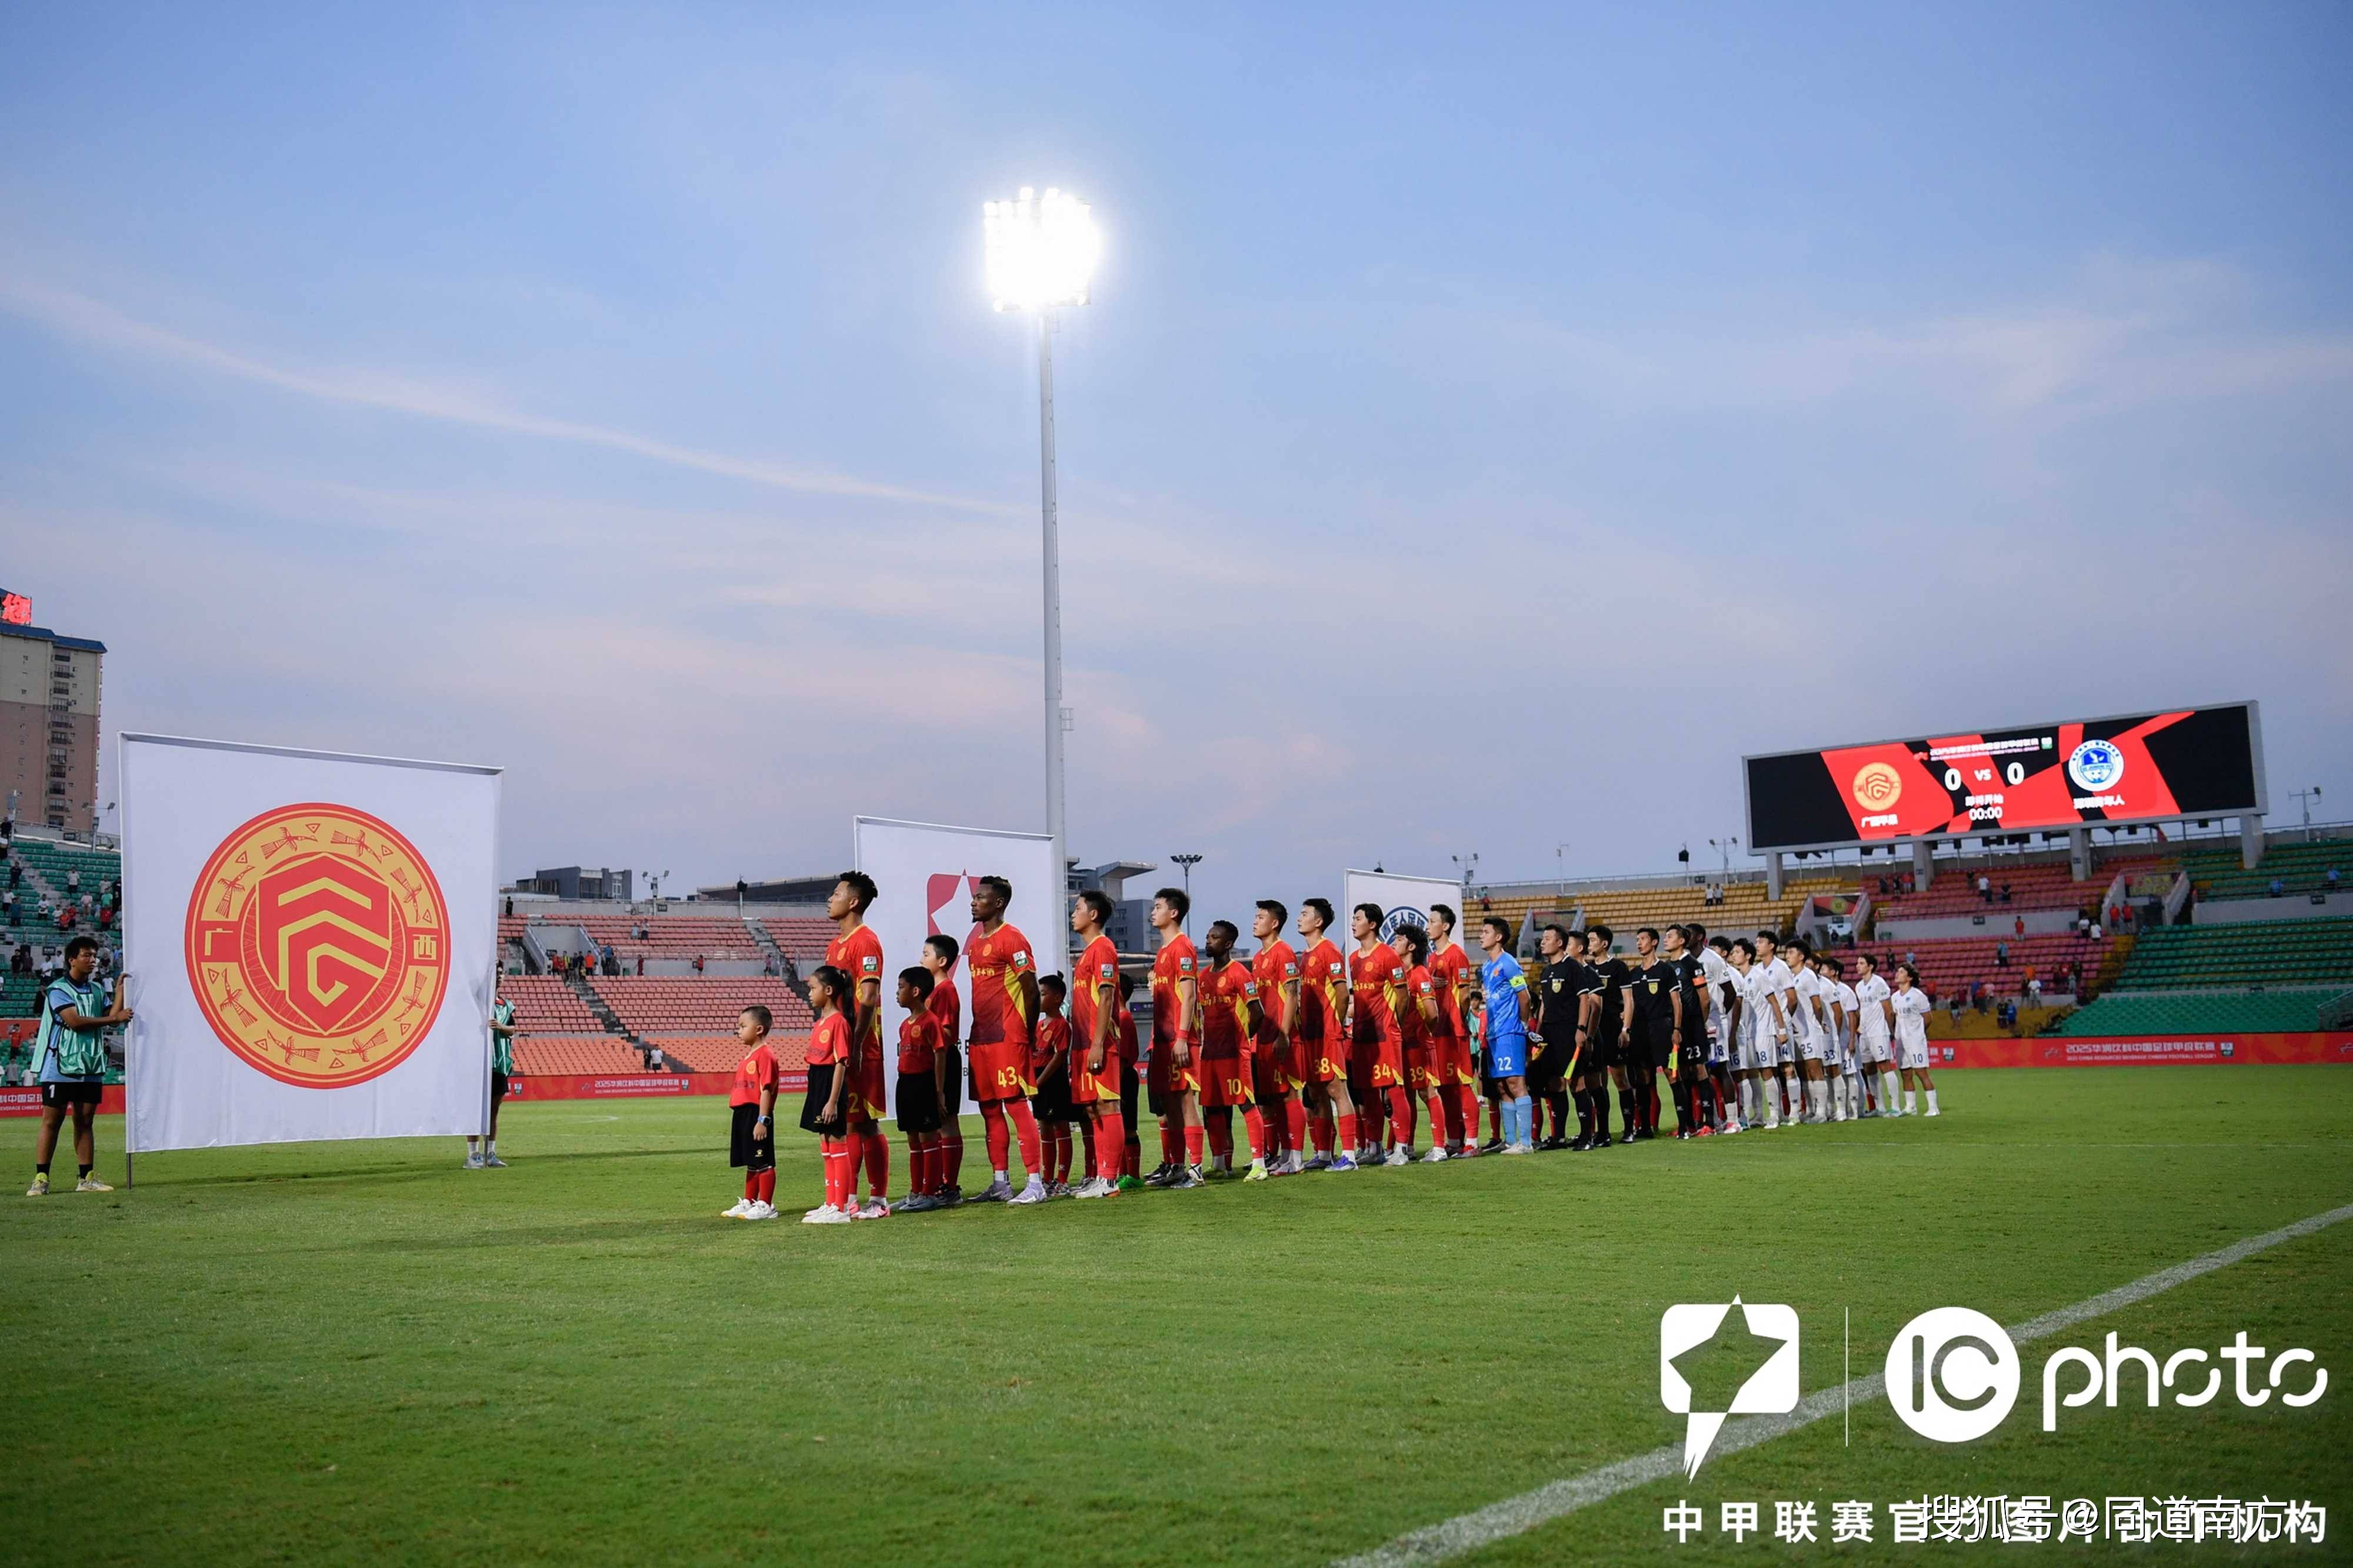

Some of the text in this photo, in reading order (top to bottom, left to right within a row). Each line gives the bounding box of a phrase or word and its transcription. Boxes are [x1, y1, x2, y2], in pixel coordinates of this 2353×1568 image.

[1945, 762, 2024, 791] 0 VS 0
[1969, 806, 2003, 820] 00:00
[1686, 1045, 1701, 1059] 23
[1777, 1046, 1789, 1057] 14
[1801, 1043, 1812, 1055] 25
[1824, 1049, 1835, 1061] 33
[1878, 1045, 1885, 1055] 3
[1498, 1056, 1512, 1071] 22
[1729, 1054, 1740, 1066] 16
[1755, 1050, 1767, 1063] 18
[1912, 1053, 1923, 1063] 10
[1314, 1057, 1331, 1075] 38
[1373, 1063, 1391, 1080] 34
[1446, 1062, 1454, 1077] 5
[998, 1066, 1018, 1088] 43
[1409, 1066, 1425, 1083] 39
[48, 1084, 55, 1099] 1
[1227, 1078, 1242, 1096] 10
